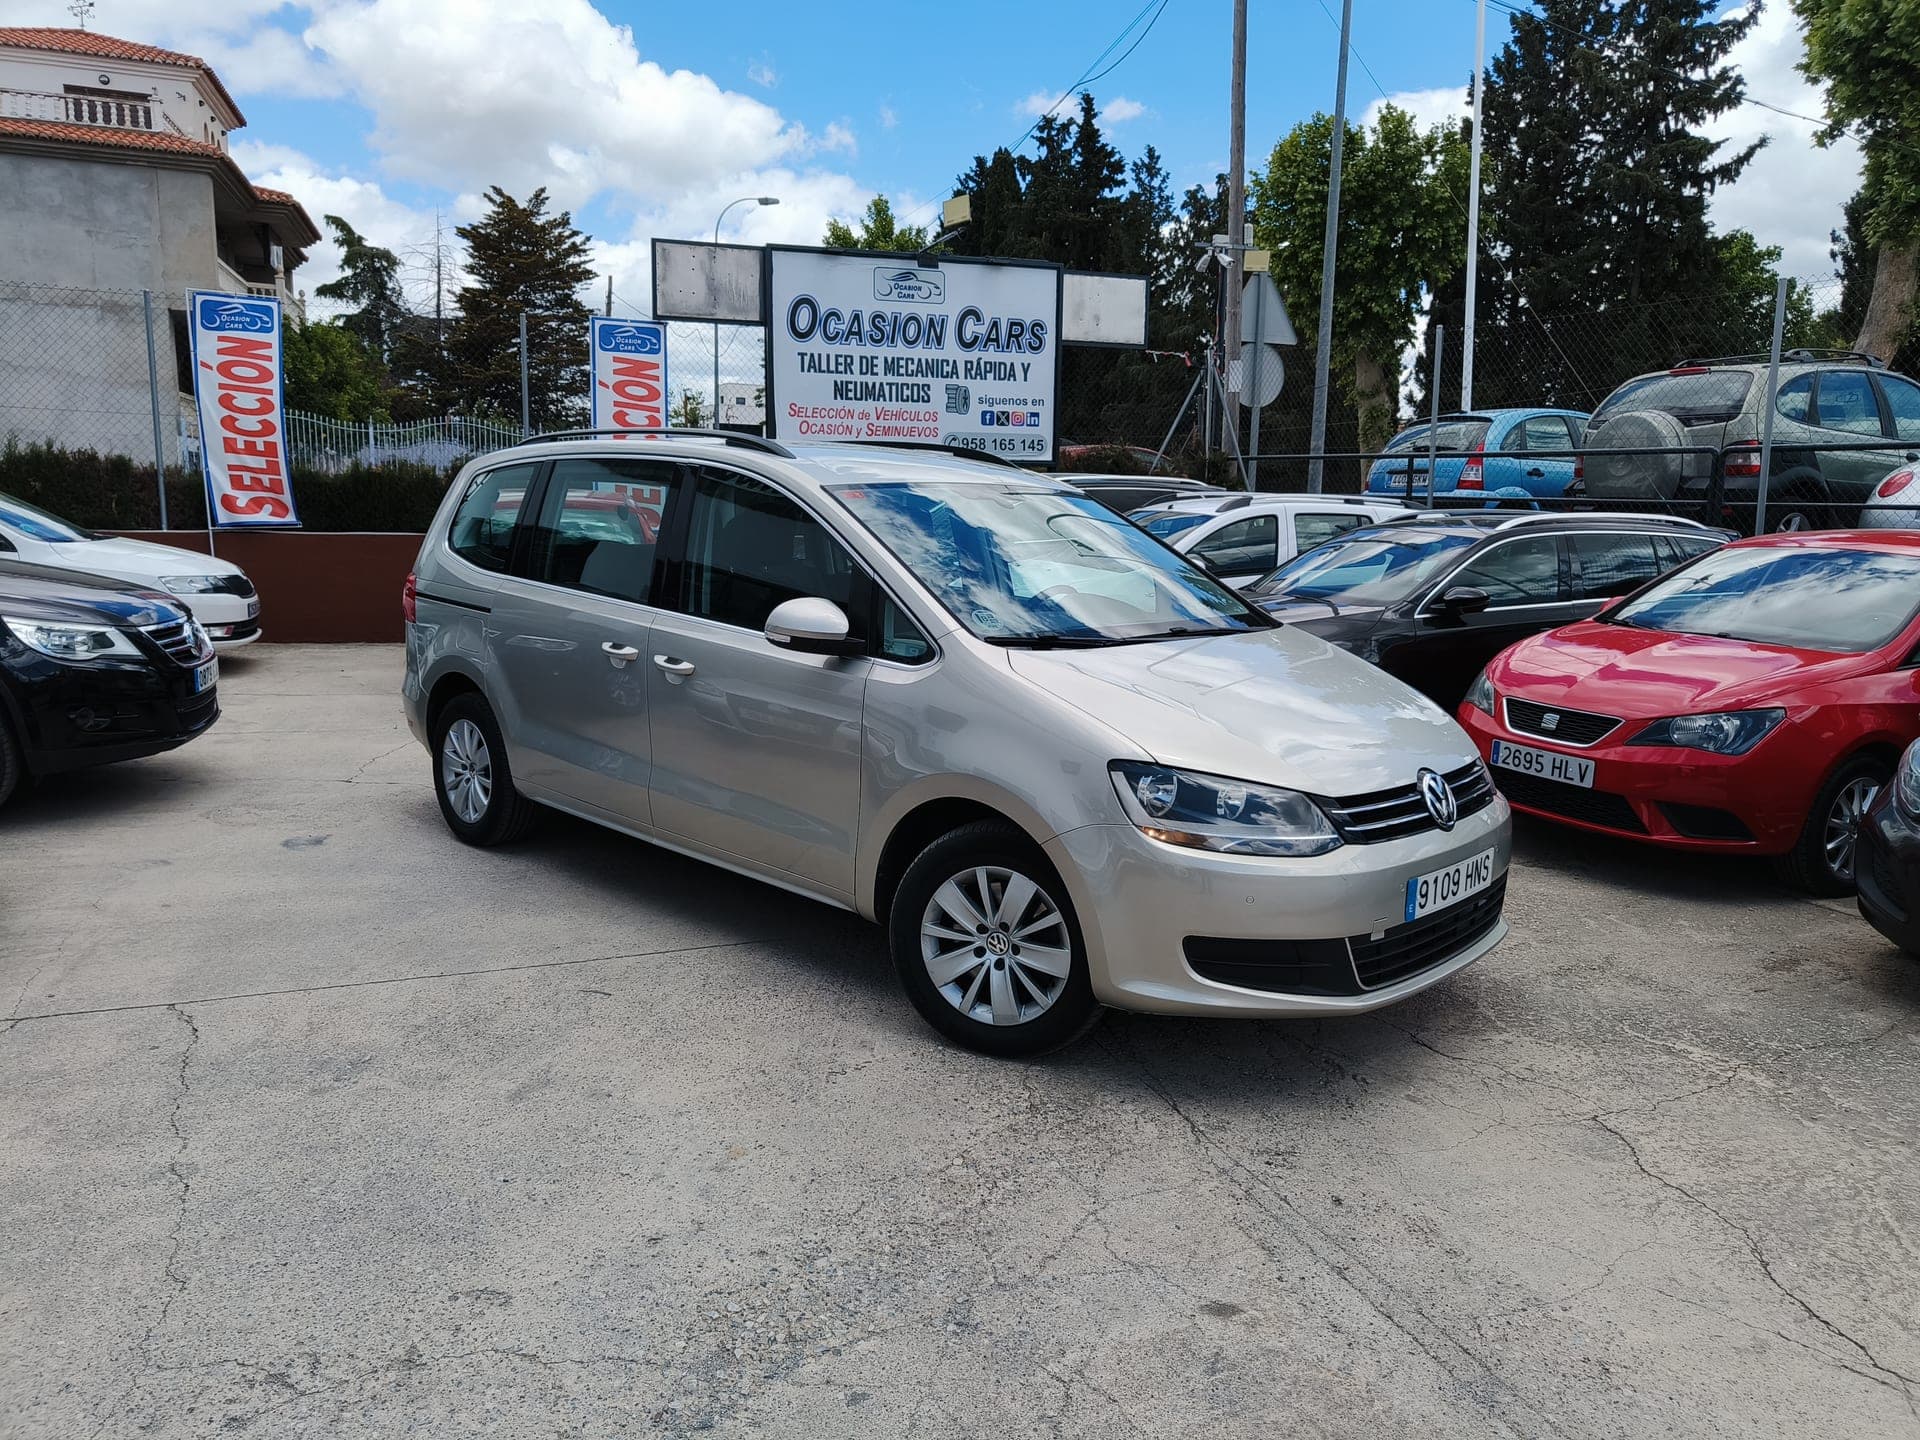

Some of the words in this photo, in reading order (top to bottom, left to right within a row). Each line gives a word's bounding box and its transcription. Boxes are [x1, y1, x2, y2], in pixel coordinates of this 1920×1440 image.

[786, 294, 948, 350] OCASION
[954, 305, 1048, 355] CARS
[797, 352, 854, 375] TALLER
[859, 355, 879, 376] DE
[883, 356, 959, 379] MECANICA
[964, 357, 1017, 382] RÁPIDA
[1020, 362, 1031, 382] Y
[833, 379, 931, 403] NEUMATICOS
[1031, 398, 1045, 406] en
[788, 403, 855, 419] SELECCIÓN
[857, 409, 871, 420] de
[874, 406, 939, 423] VEHÍCULOS
[200, 335, 290, 519] SELECCIÓN
[799, 420, 853, 436] OCASIÓN
[855, 427, 862, 438] y
[865, 422, 939, 438] SEMINUEVOS
[961, 437, 987, 450] 958
[991, 438, 1016, 451] 165
[1020, 438, 1044, 452] 145
[1501, 746, 1544, 773] 2695
[1551, 757, 1589, 784] HLV
[1418, 867, 1461, 910] 9109
[1464, 854, 1490, 892] HNS
